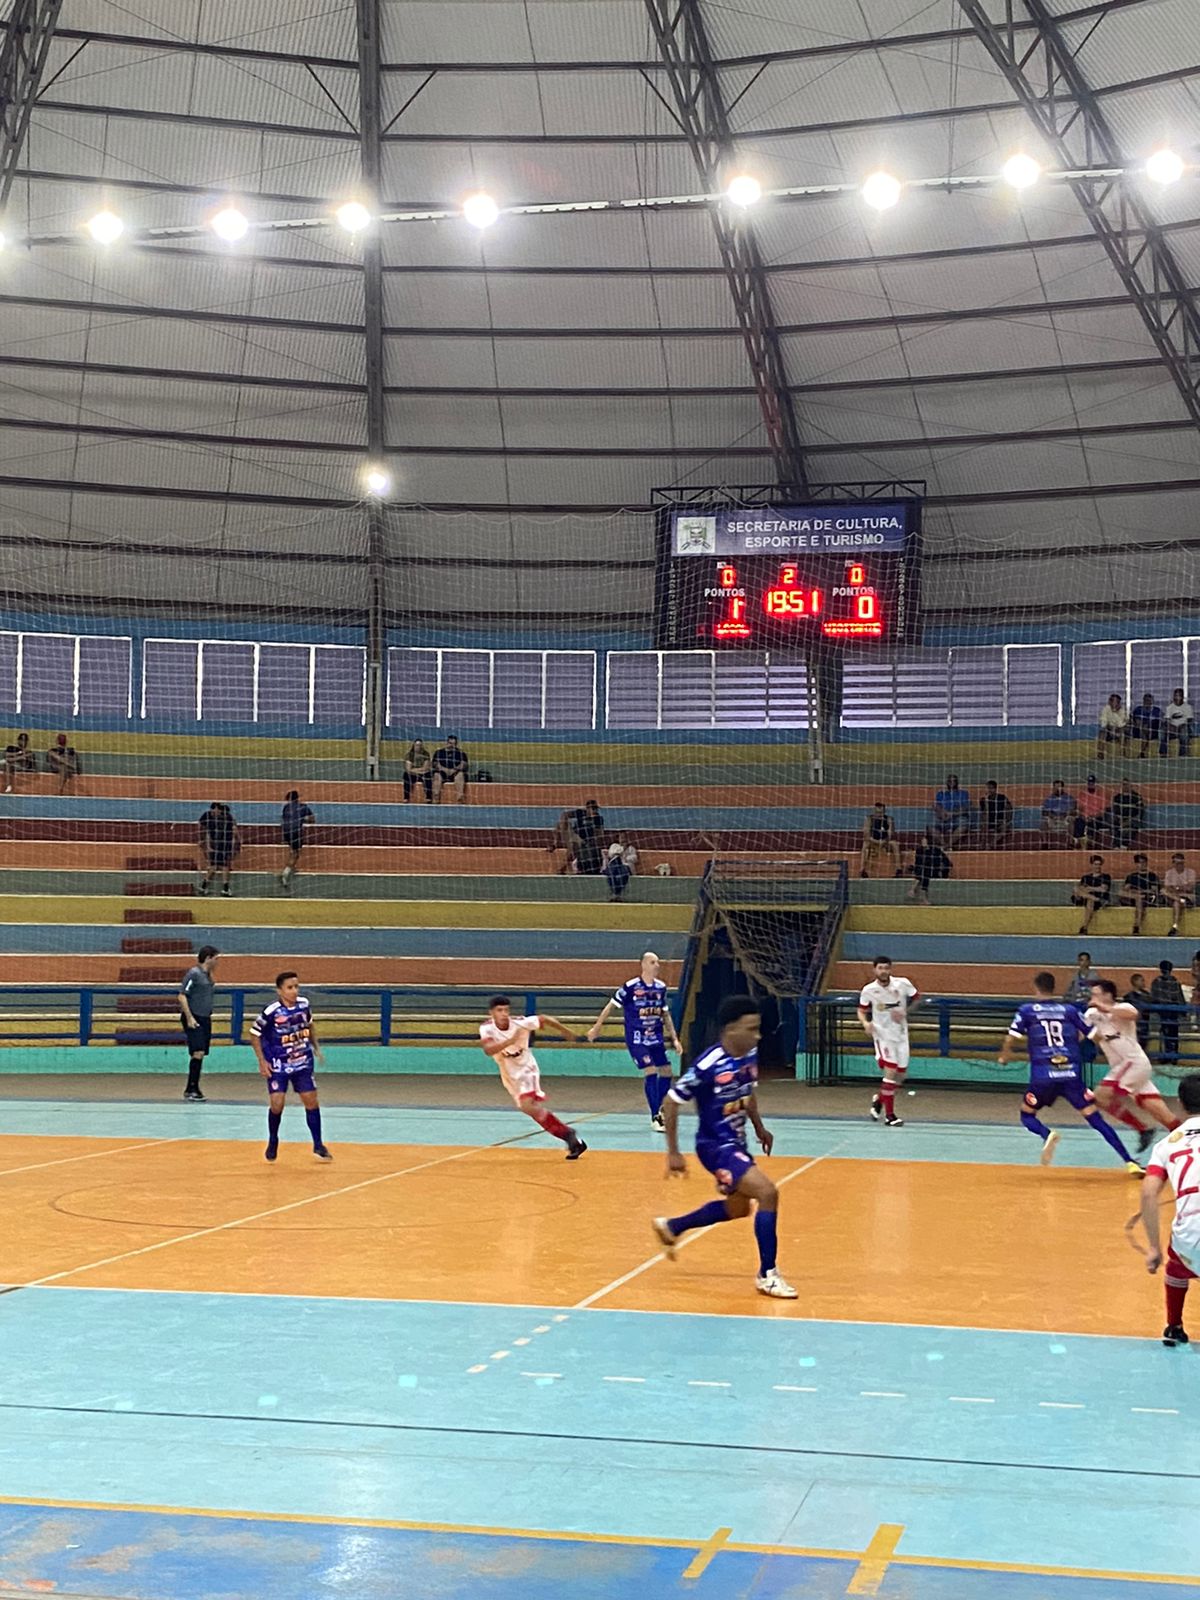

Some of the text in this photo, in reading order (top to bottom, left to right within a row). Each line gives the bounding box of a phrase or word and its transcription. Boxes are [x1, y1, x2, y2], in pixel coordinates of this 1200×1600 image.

[727, 517, 903, 533] SECRETARIA DE CULTURA,
[745, 533, 884, 548] ESPORTE E TURISMO
[722, 568, 734, 585] 0
[783, 568, 794, 584] 2
[850, 567, 862, 584] 0
[704, 588, 745, 597] PONTOS
[832, 587, 874, 597] PONTOS
[858, 596, 874, 619] 0
